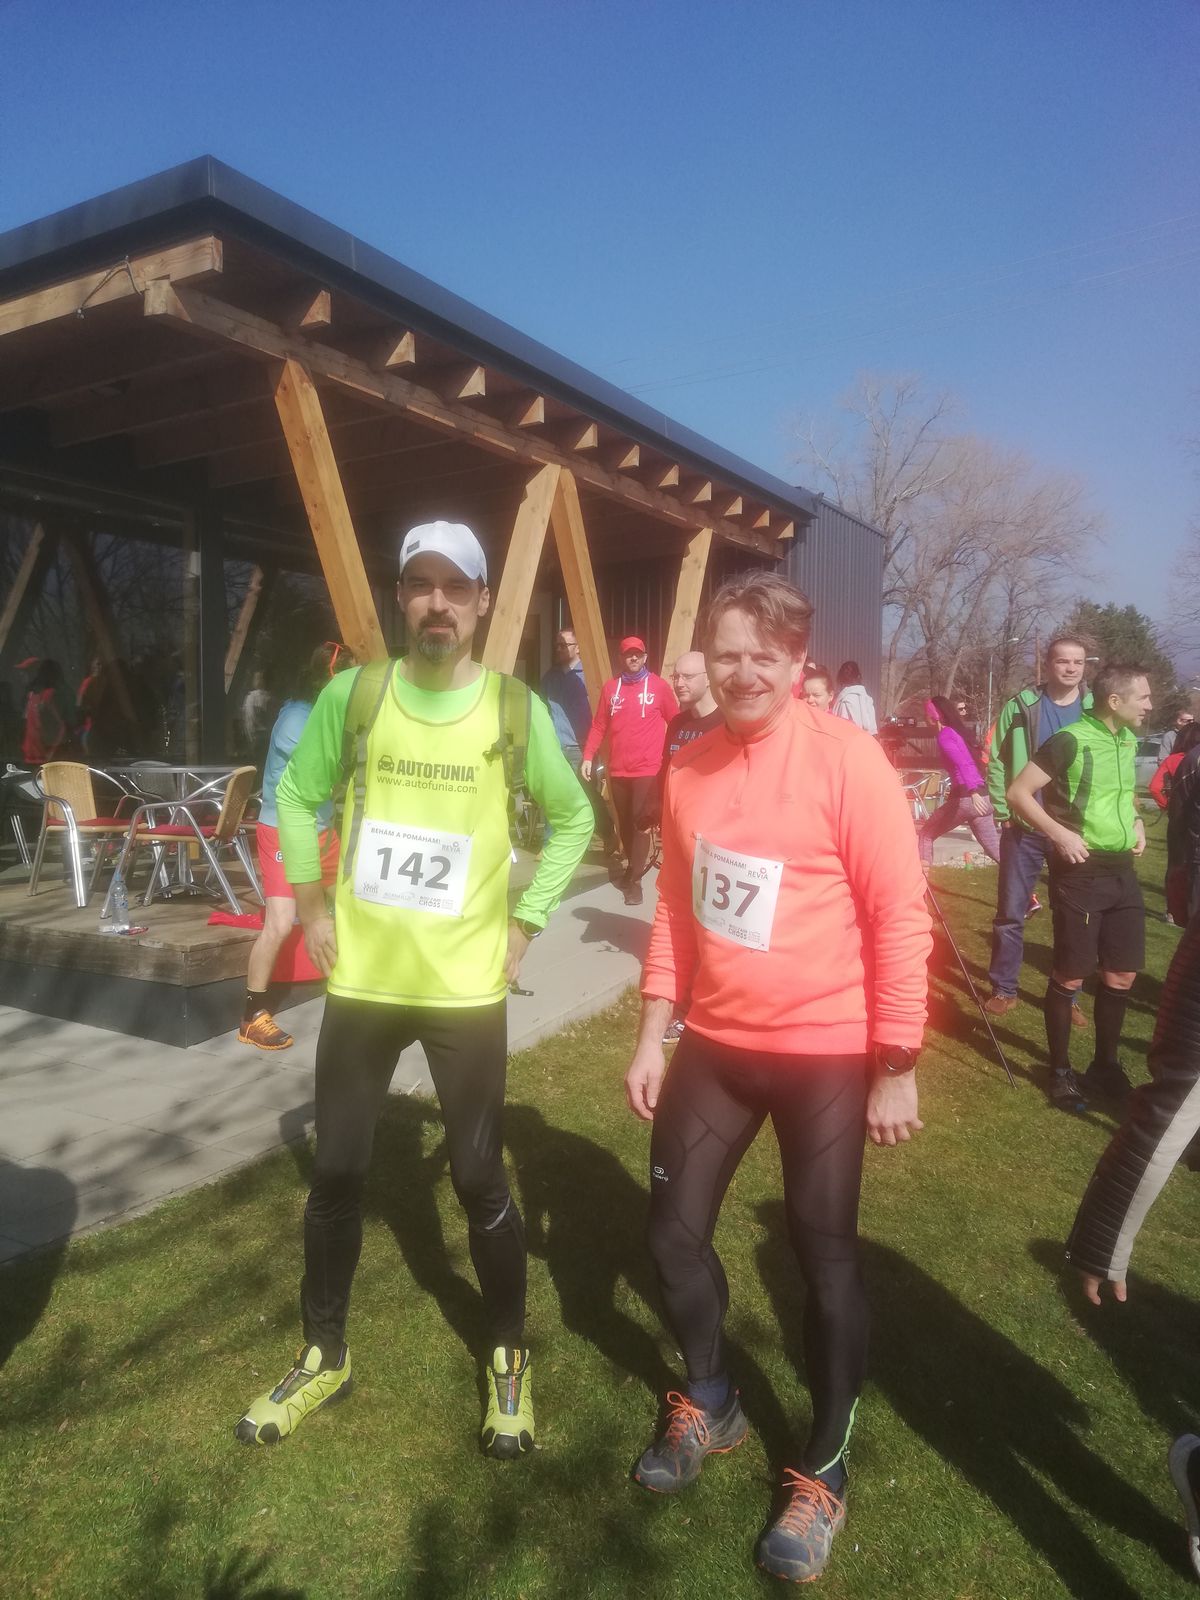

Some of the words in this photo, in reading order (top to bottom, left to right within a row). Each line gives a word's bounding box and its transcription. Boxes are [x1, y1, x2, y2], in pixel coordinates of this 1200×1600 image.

[396, 759, 475, 782] AUTOFUNIA
[376, 775, 478, 794] www.autofunia.com
[377, 847, 451, 891] 142
[747, 870, 769, 880] REVIA
[700, 866, 761, 918] 137
